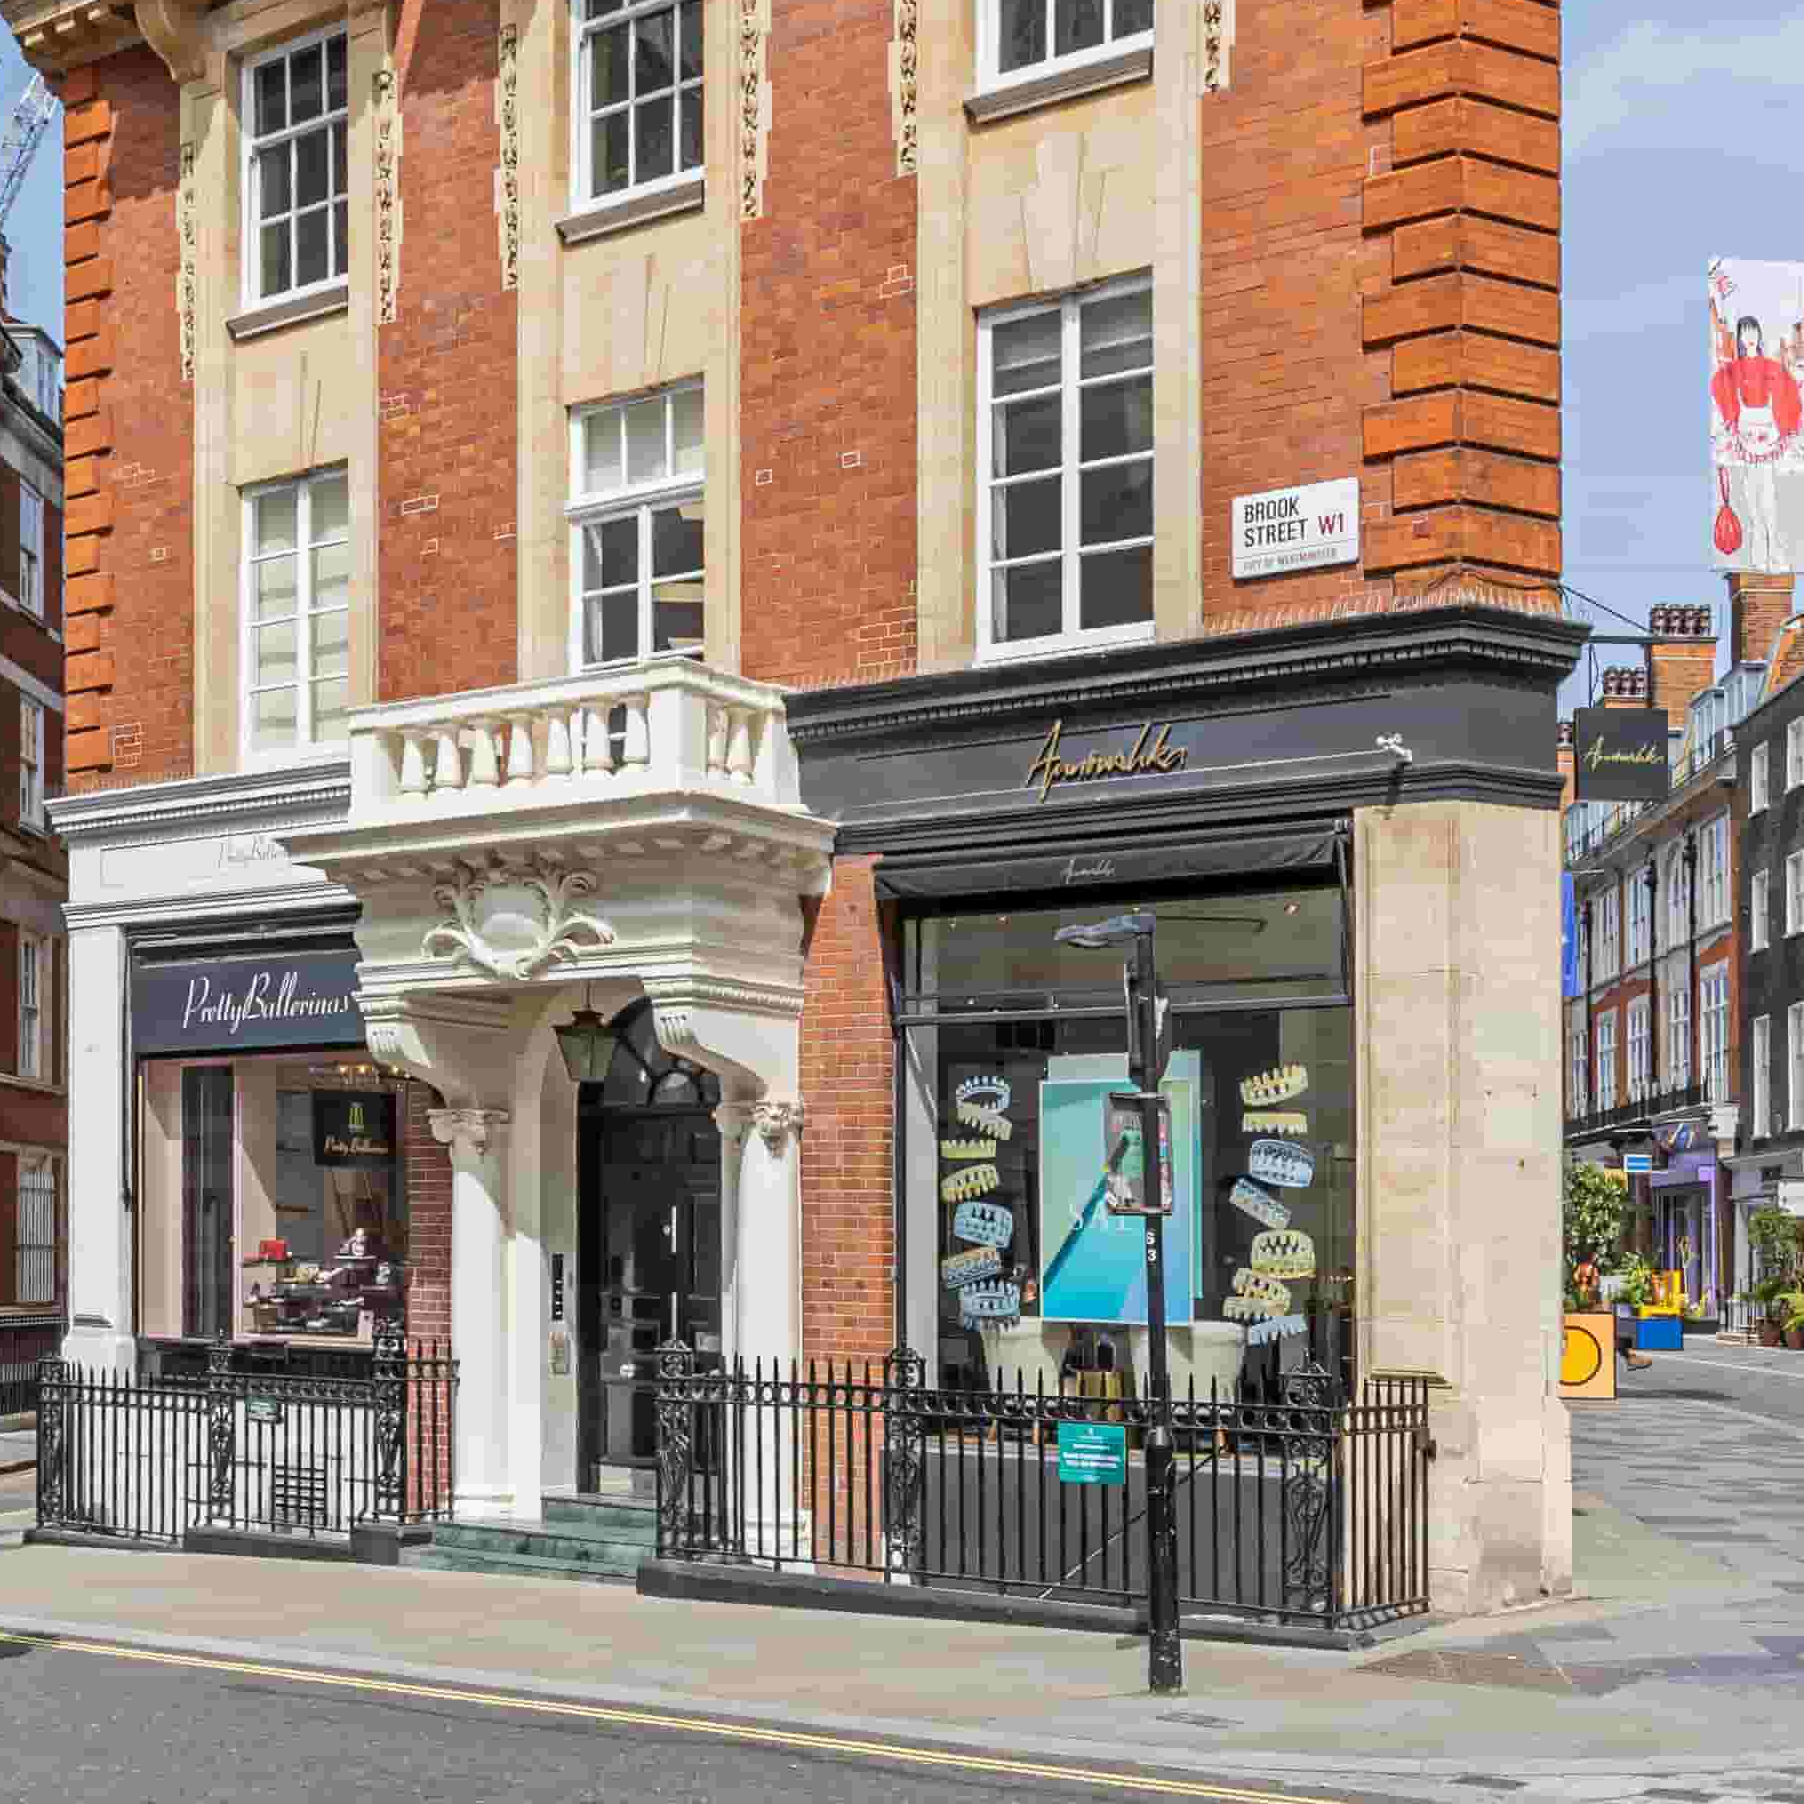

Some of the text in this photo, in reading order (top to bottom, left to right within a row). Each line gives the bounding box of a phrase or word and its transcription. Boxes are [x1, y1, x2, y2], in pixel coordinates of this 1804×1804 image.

[1243, 496, 1300, 525] BROOK
[1243, 511, 1345, 548] STREET W1
